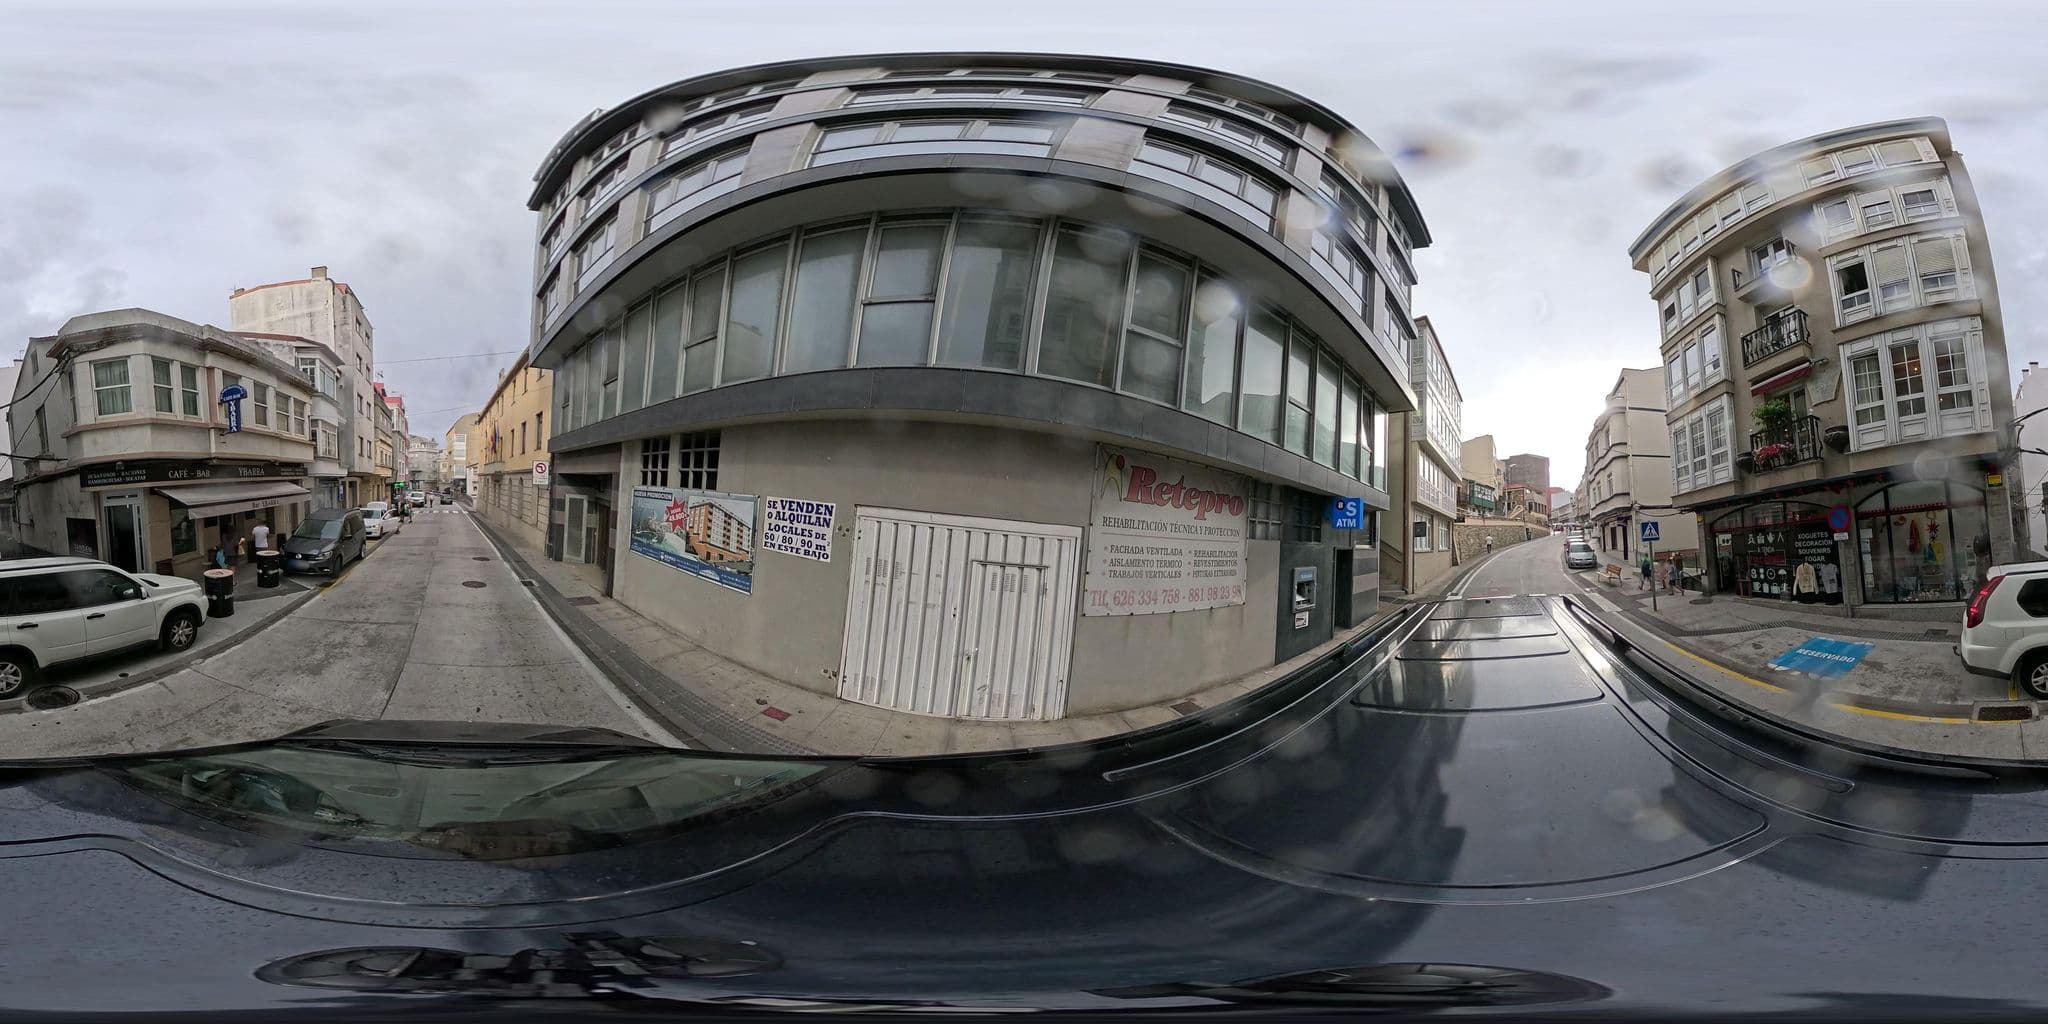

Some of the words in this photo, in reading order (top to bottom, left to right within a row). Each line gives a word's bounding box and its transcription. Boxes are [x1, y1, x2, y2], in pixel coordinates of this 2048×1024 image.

[168, 467, 189, 479] CAFÉ
[196, 469, 210, 478] BAR
[238, 467, 265, 477] YBARRA
[1123, 465, 1244, 520] Retepro
[767, 500, 778, 509] SE
[780, 499, 834, 517] VENDEN
[1346, 501, 1357, 516] S
[775, 510, 831, 528] ALQUILAN
[1336, 518, 1357, 528] ATM
[767, 522, 814, 538] LOCALES
[815, 532, 827, 541] DE
[1797, 531, 1829, 540] XOGUETES
[764, 532, 775, 541] 60
[781, 535, 793, 545] 80
[800, 538, 813, 549] 90
[763, 541, 776, 549] EN
[777, 544, 801, 554] ESTE
[803, 549, 829, 560] BAJO
[1110, 544, 1145, 555] FACHADA
[1146, 546, 1183, 556] VENTILADA
[1797, 547, 1831, 555] SOUVENIRS
[1108, 558, 1154, 568] AISLAMIENTO
[1193, 559, 1238, 568] REVESTIMIENTOS
[1108, 570, 1144, 579] TRABAJOS
[1145, 570, 1182, 579] VERTICALES
[1113, 590, 1136, 606] 626
[1138, 590, 1158, 605] 334
[1161, 589, 1181, 604] 758
[1188, 587, 1205, 602] 881
[1206, 586, 1218, 601] 98
[1796, 648, 1855, 663] RESERVADO
